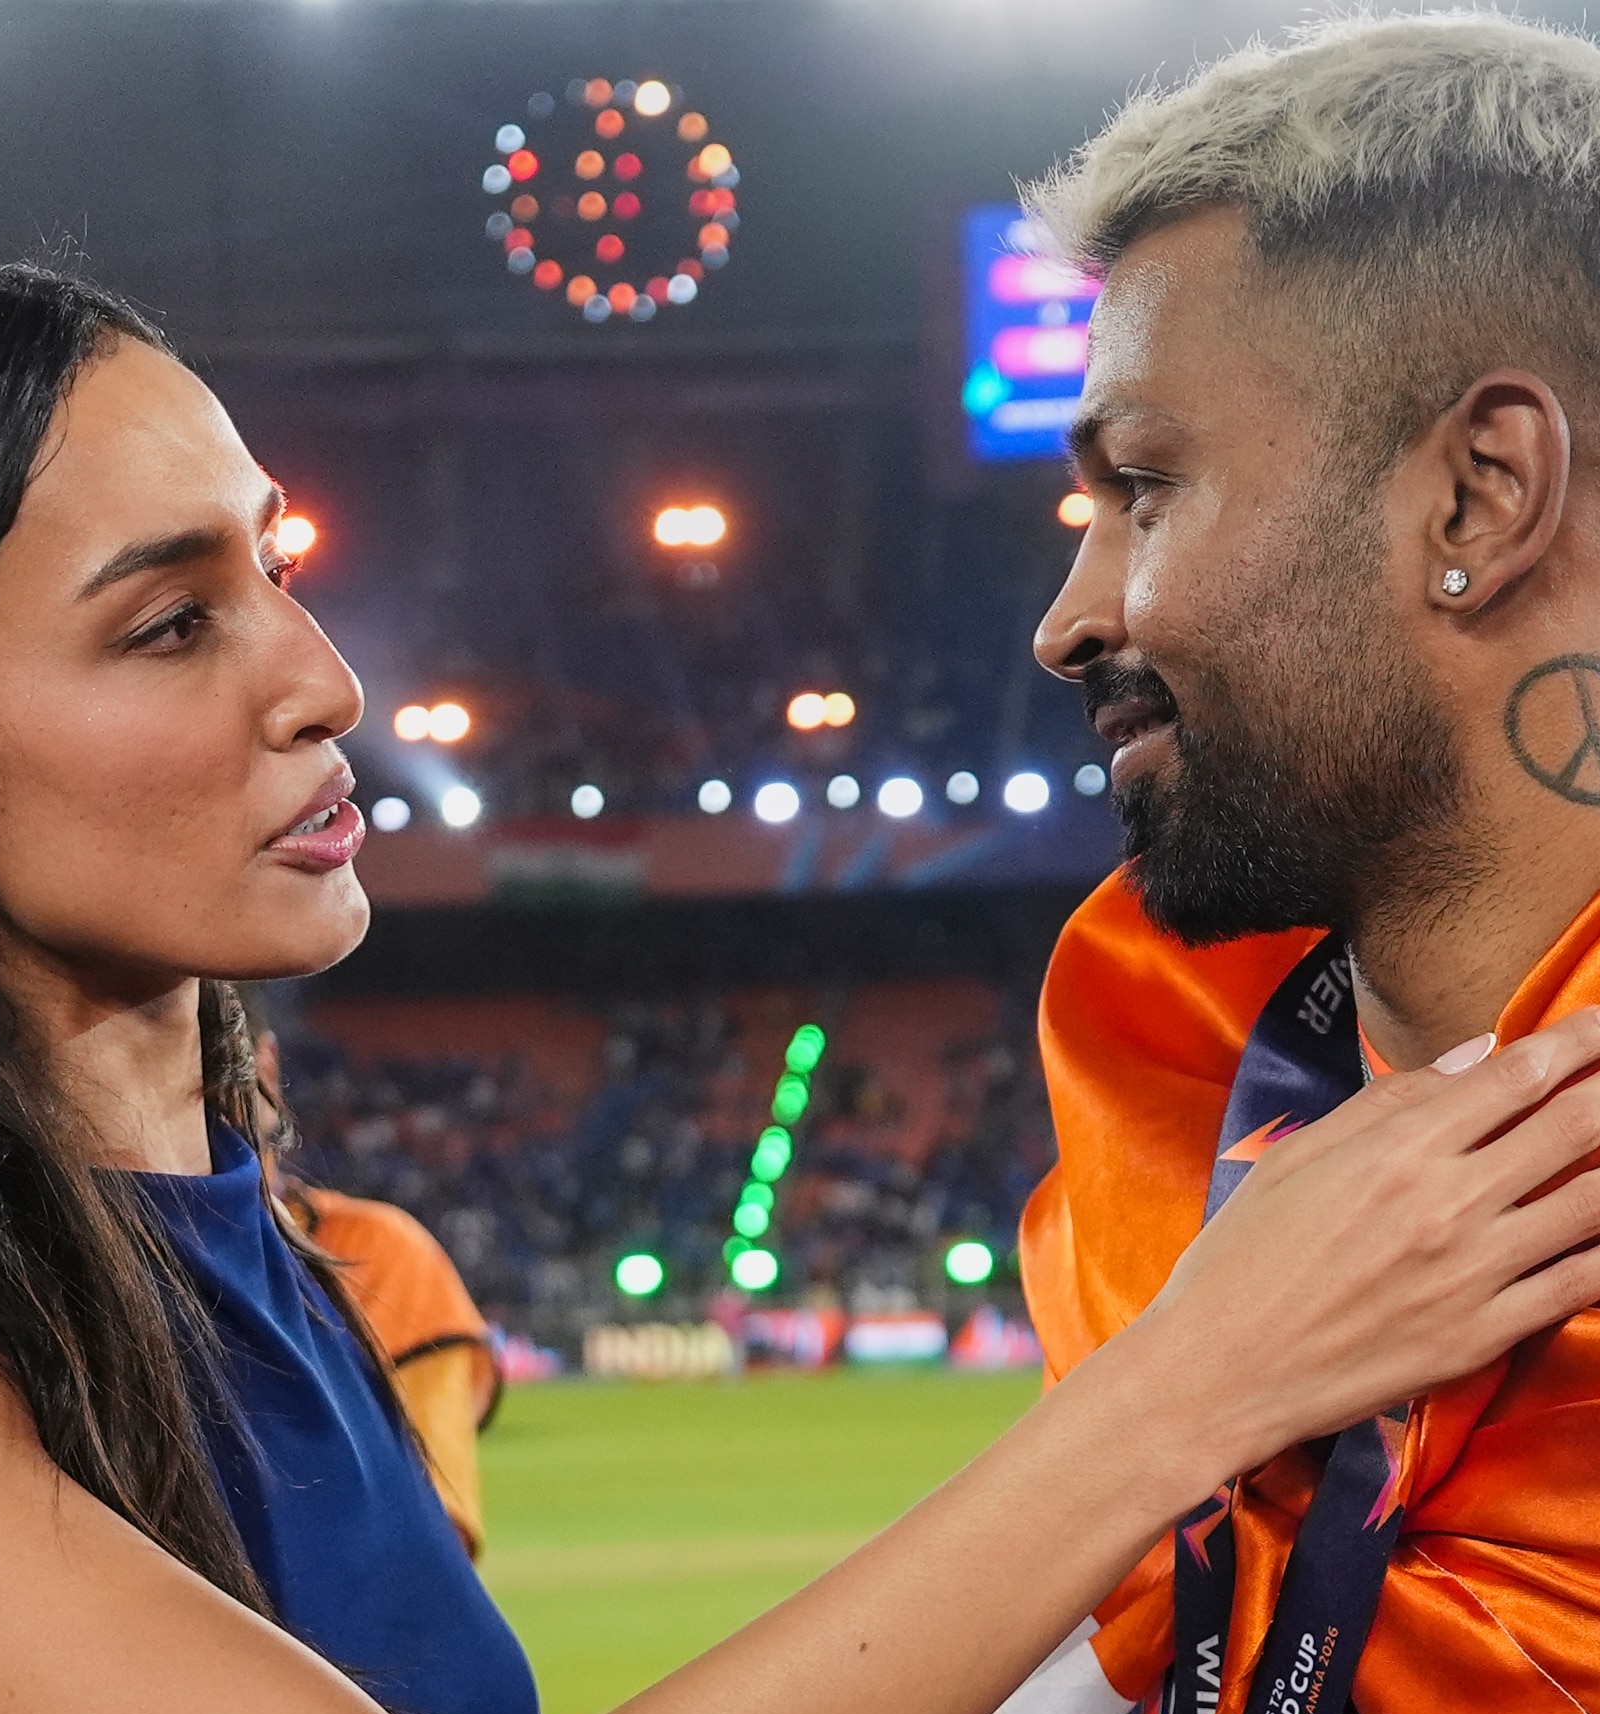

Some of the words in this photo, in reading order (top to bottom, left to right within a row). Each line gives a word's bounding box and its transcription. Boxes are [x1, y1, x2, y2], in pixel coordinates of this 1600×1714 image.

[1290, 1632, 1318, 1694] CUP
[1319, 1625, 1340, 1667] 2026
[1268, 1677, 1286, 1709] T20
